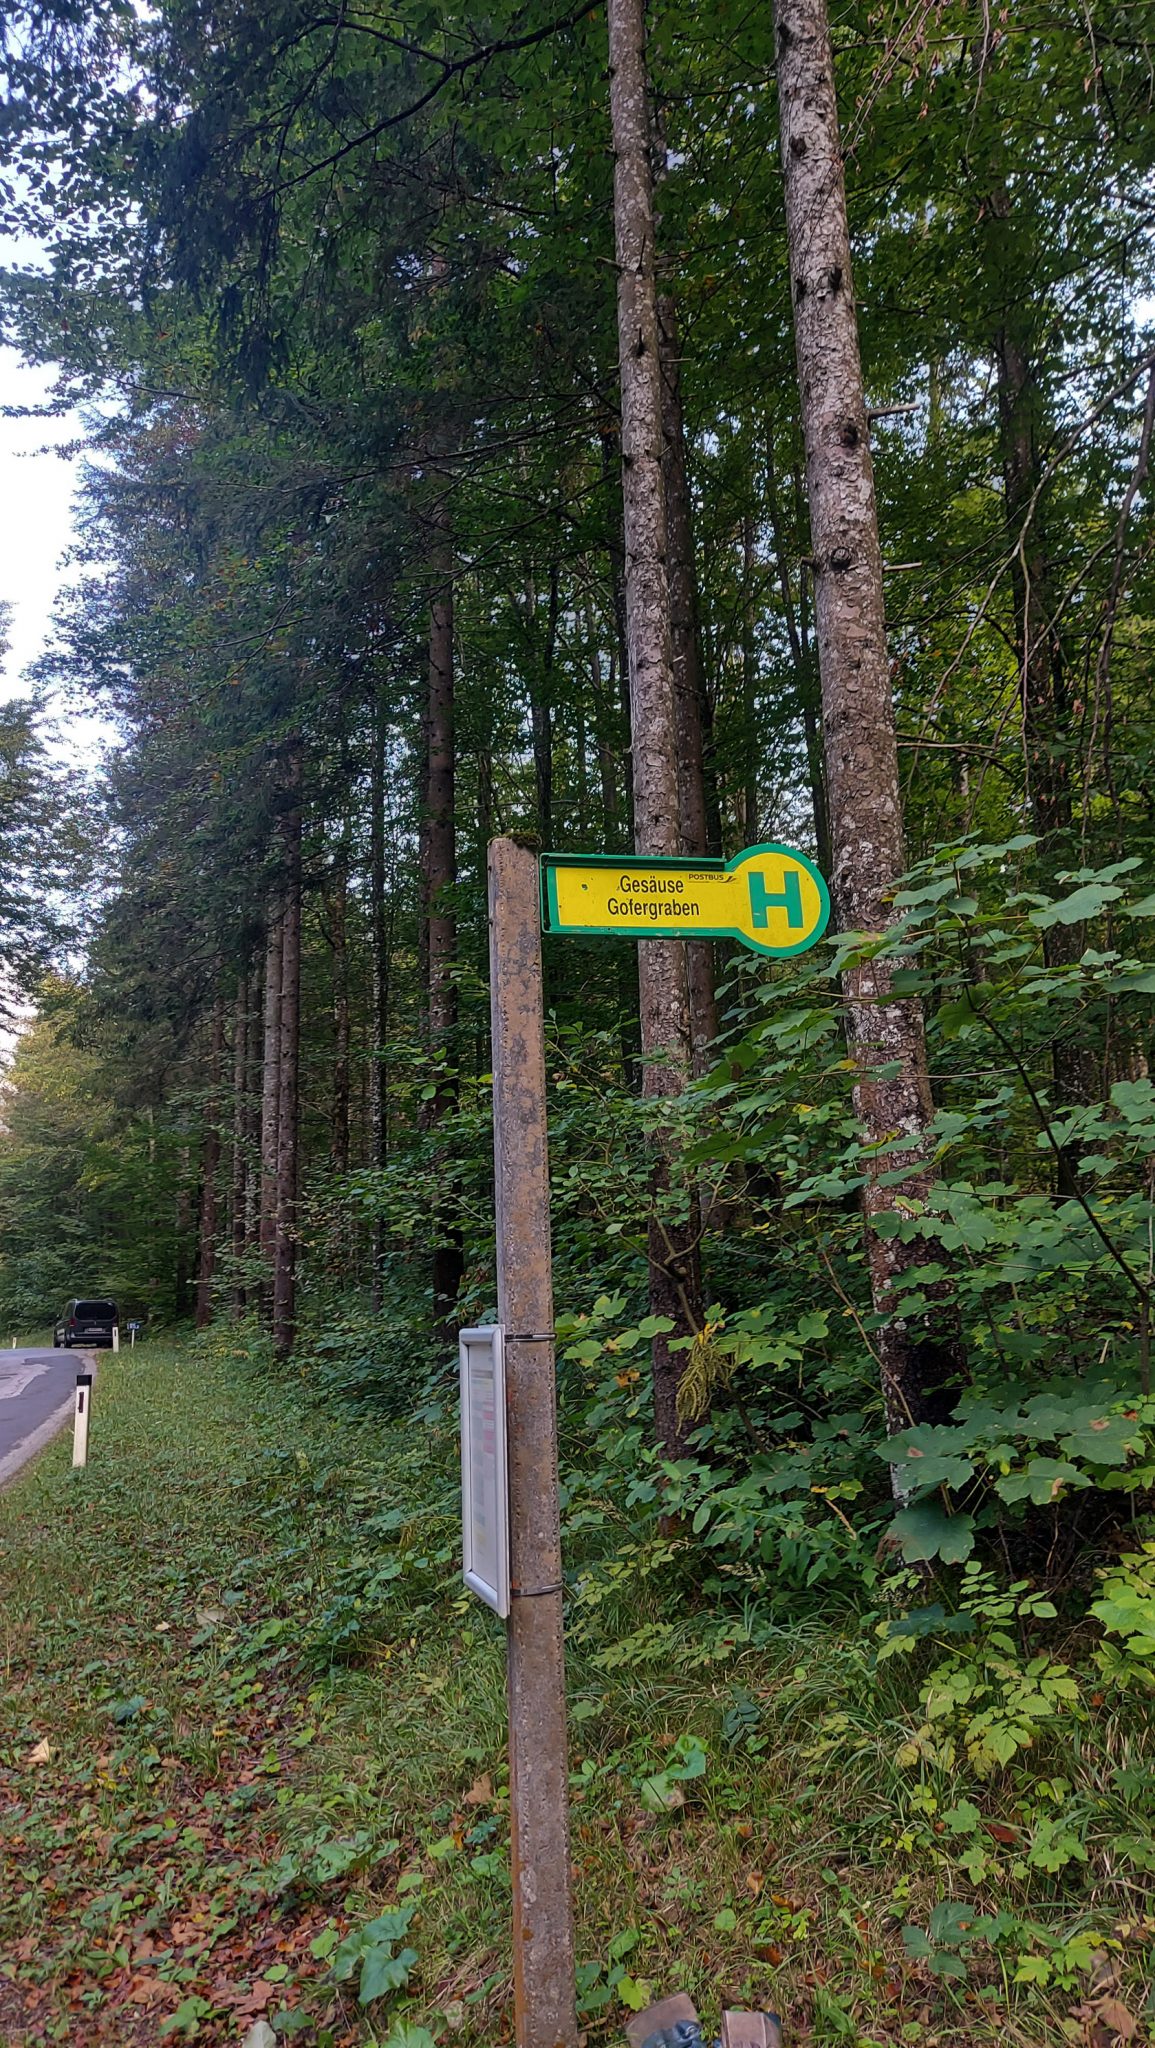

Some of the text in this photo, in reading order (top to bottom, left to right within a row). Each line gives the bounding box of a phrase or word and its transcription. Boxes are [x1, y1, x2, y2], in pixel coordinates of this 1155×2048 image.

[619, 875, 684, 893] Gesäuse
[688, 873, 724, 882] POSTBUS
[607, 898, 700, 920] Gofergraben
[748, 871, 804, 929] H
